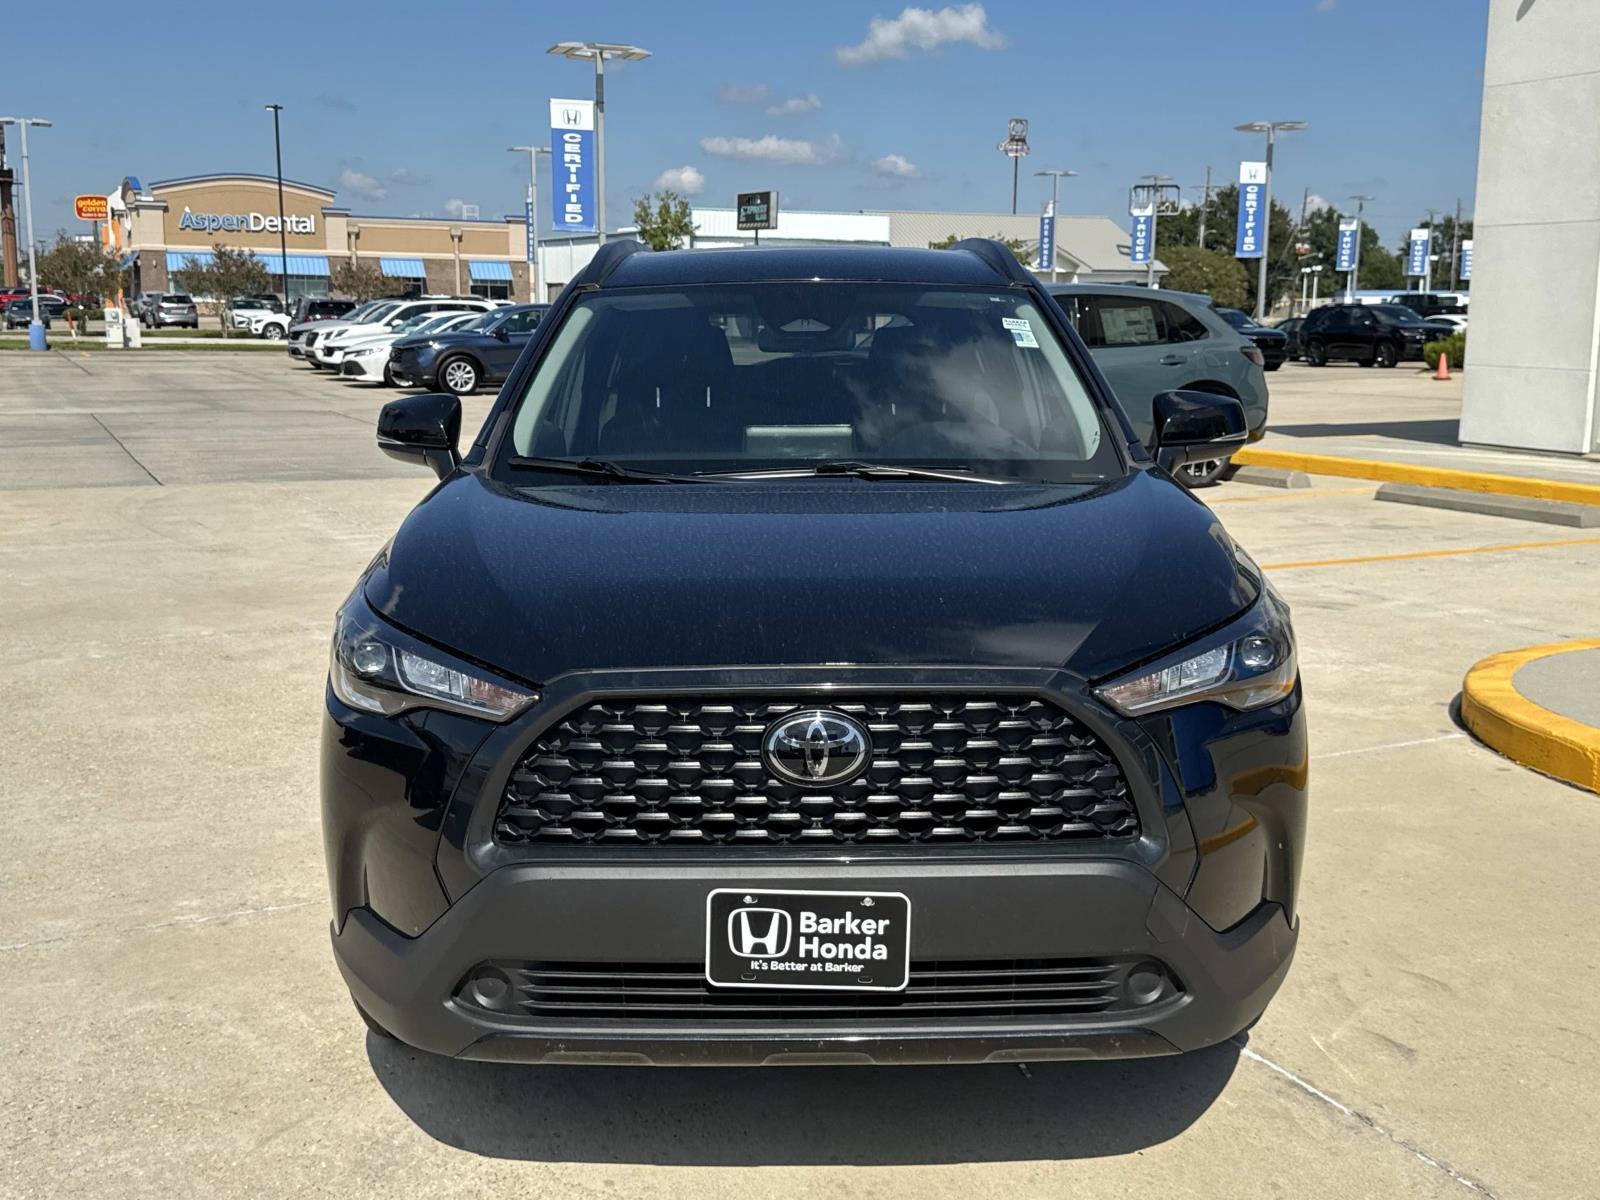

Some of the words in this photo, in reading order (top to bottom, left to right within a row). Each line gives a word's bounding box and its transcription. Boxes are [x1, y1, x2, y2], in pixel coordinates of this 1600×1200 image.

[563, 133, 583, 223] CERTIFIED
[1243, 185, 1258, 251] CERTIFIED
[1135, 216, 1146, 260] TRUCKS
[799, 911, 890, 935] Barker
[799, 936, 888, 960] Honda
[750, 959, 768, 970] It's
[770, 960, 808, 972] Better
[810, 962, 823, 972] at
[825, 962, 865, 973] Barker
